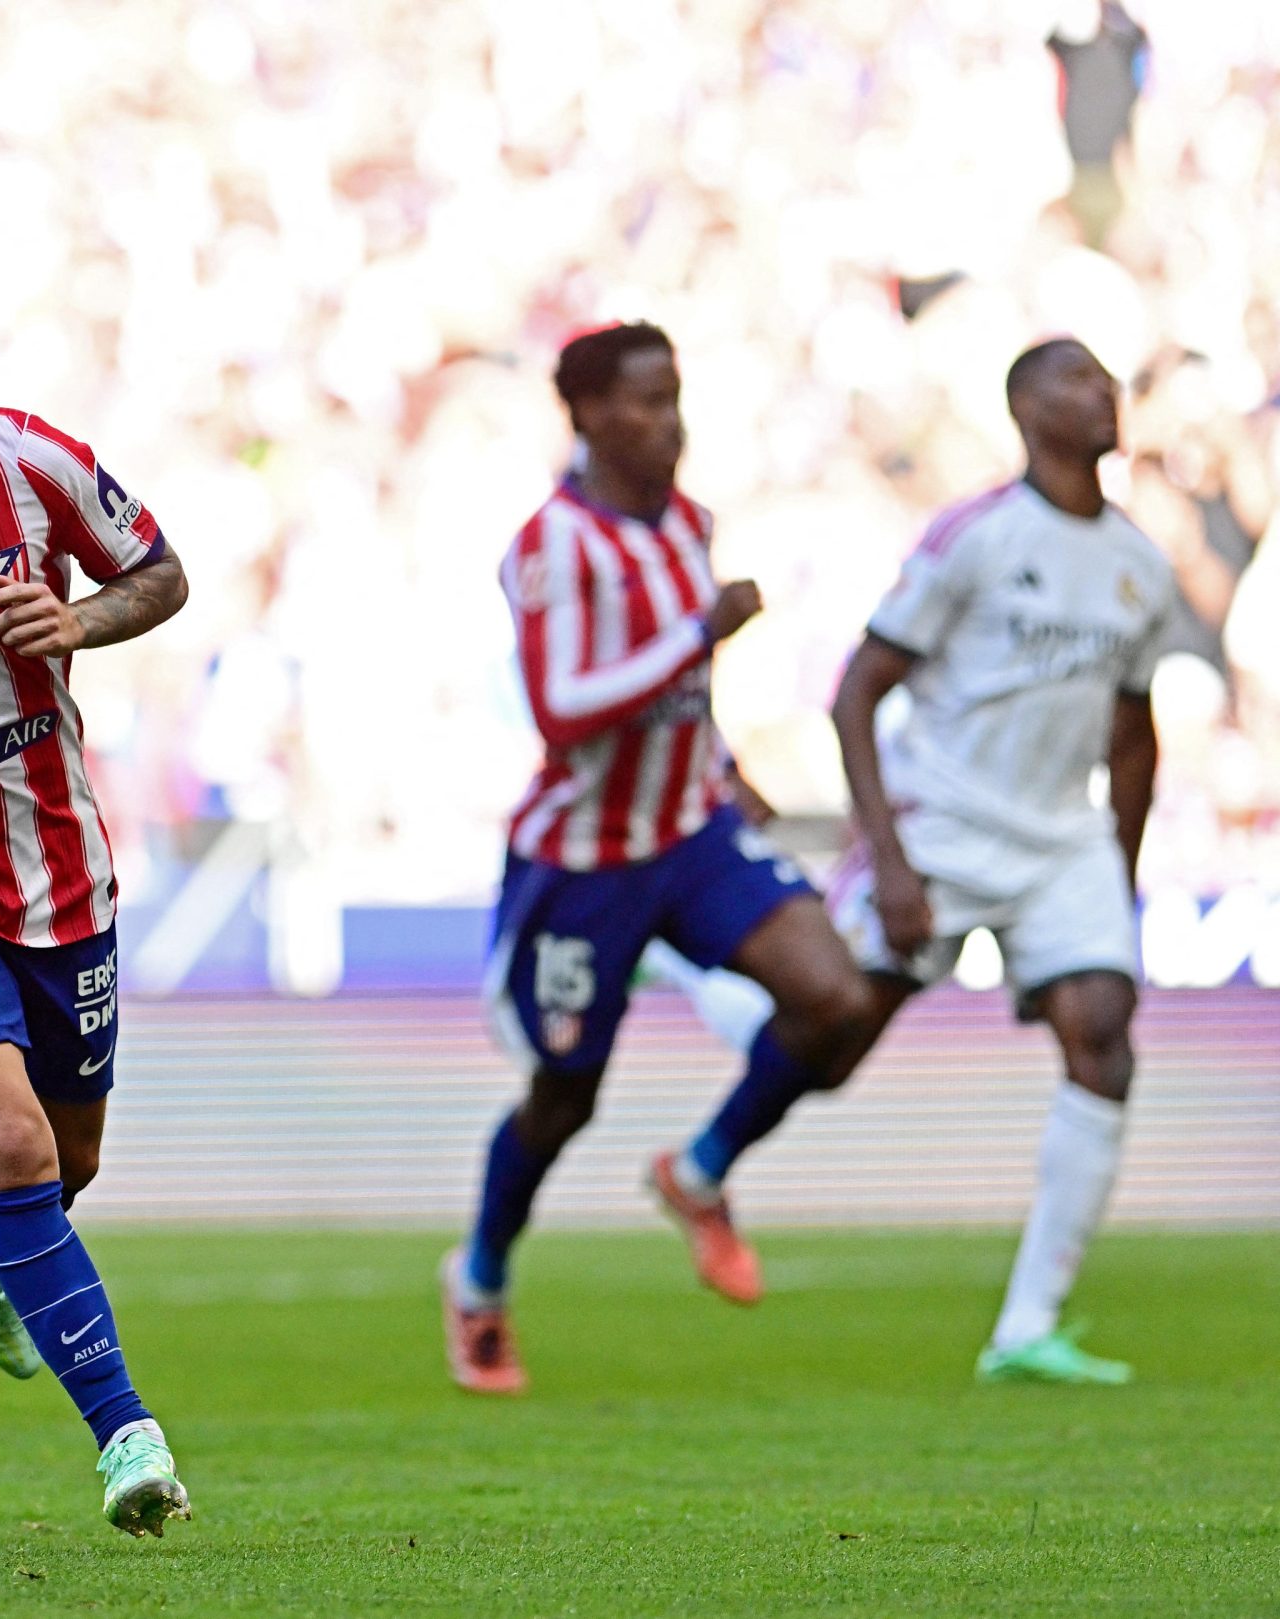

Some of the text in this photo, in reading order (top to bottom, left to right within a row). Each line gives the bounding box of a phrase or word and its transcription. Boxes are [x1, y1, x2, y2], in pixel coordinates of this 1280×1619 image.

[4, 715, 51, 754] AIR
[534, 931, 595, 1012] 15
[74, 1337, 109, 1363] ATLETI
